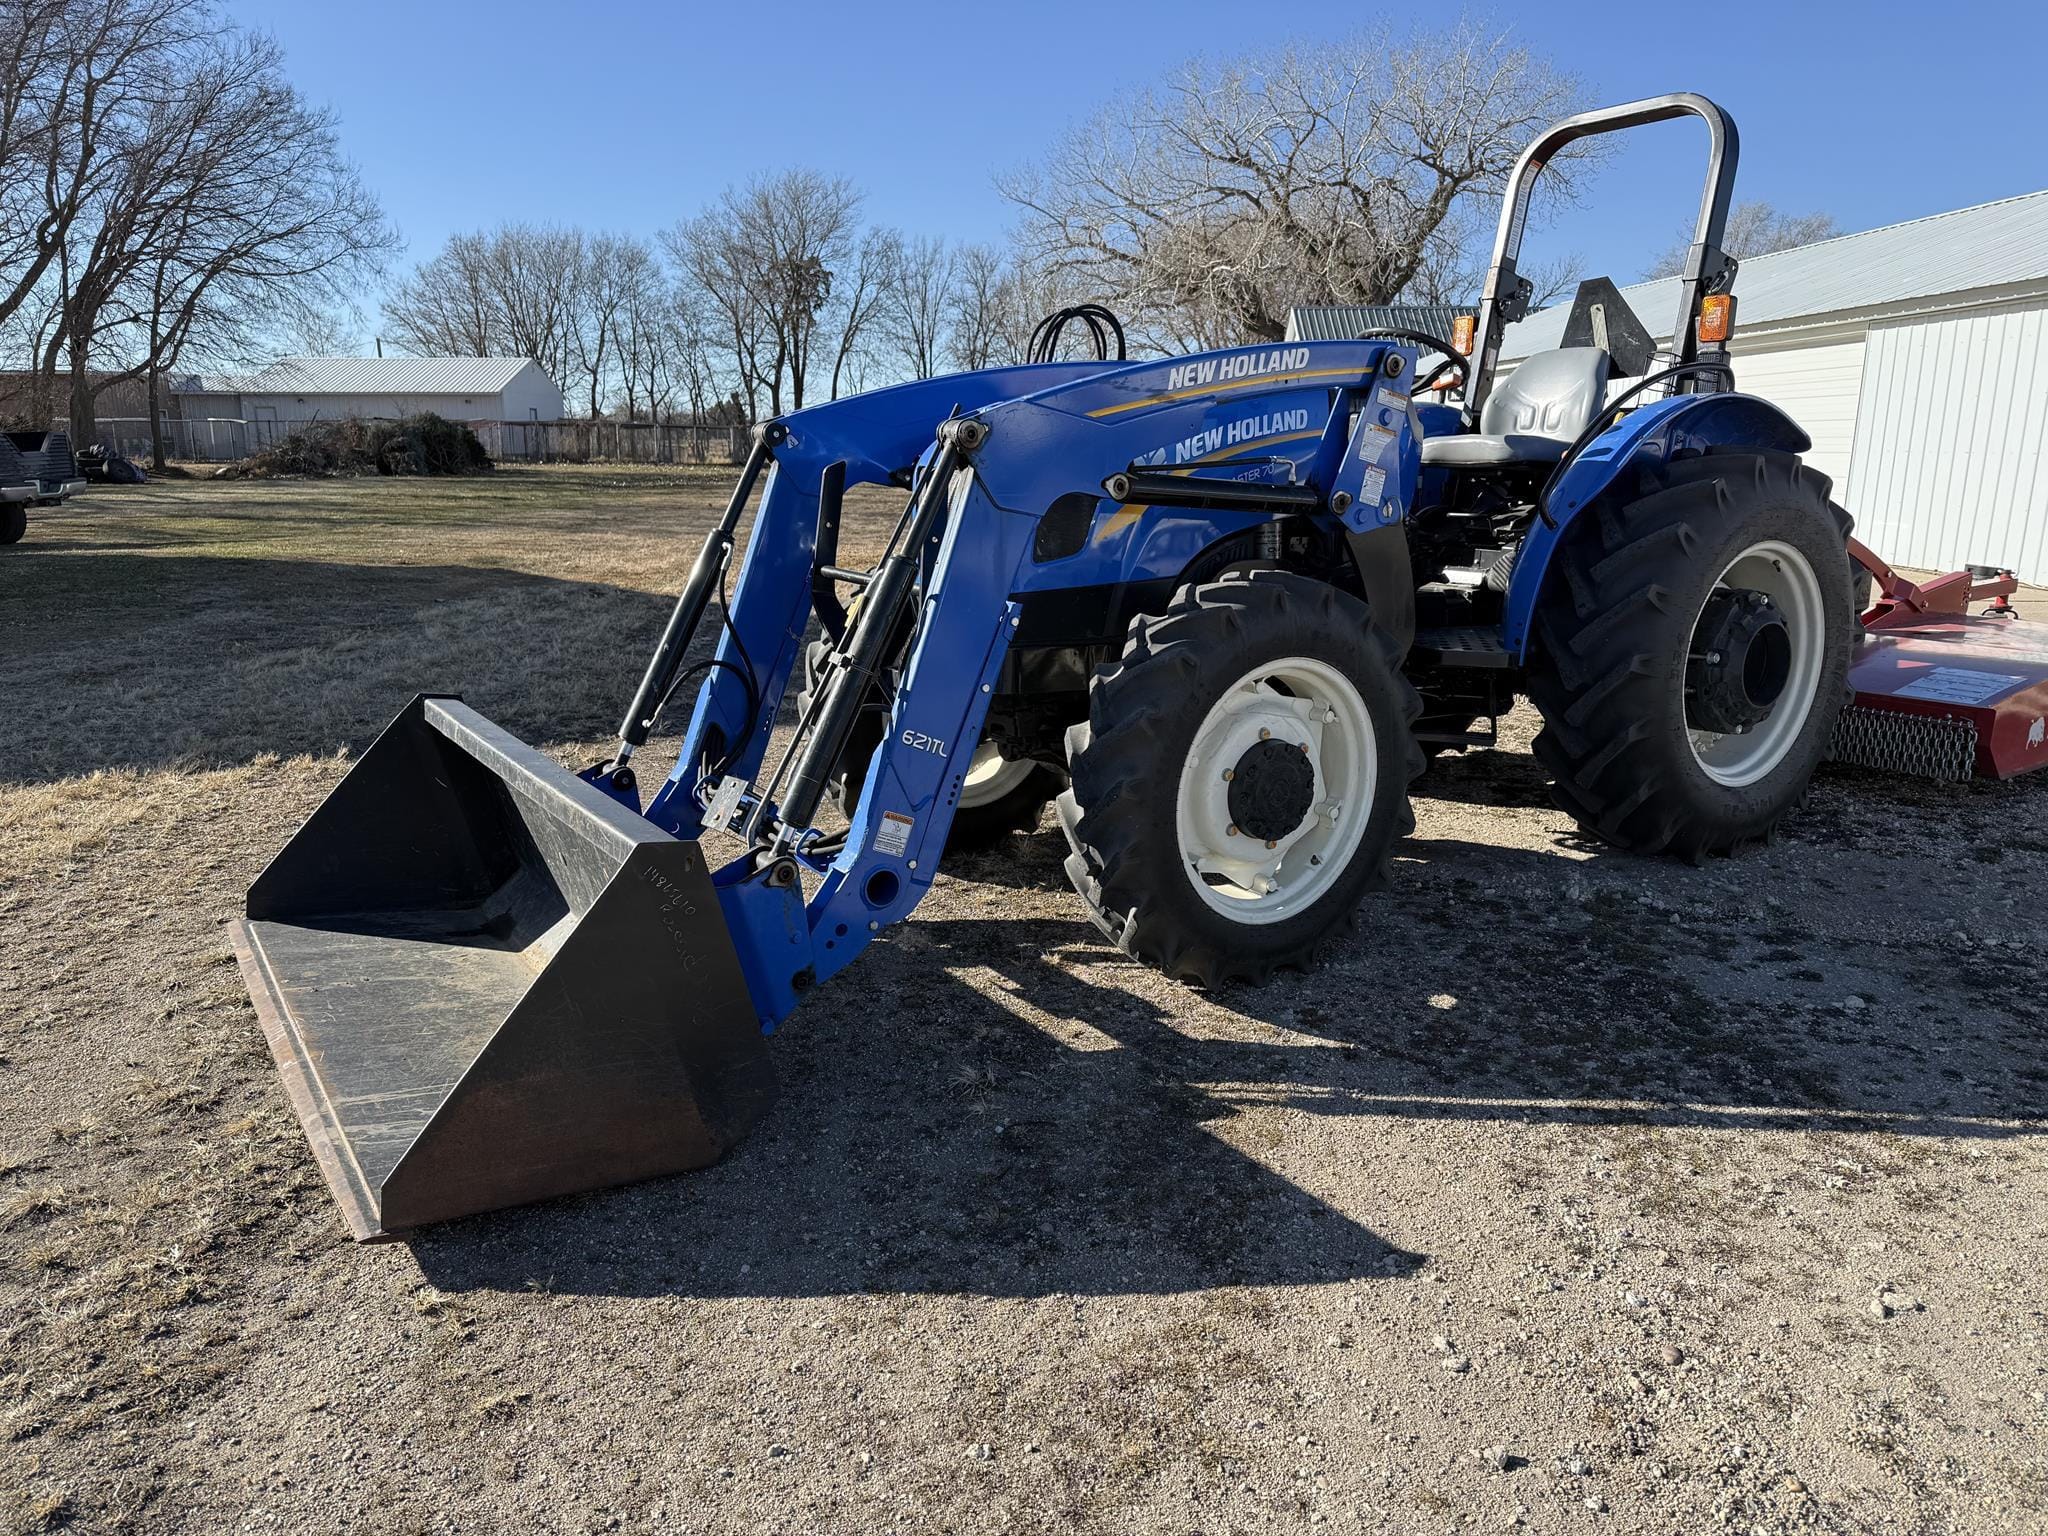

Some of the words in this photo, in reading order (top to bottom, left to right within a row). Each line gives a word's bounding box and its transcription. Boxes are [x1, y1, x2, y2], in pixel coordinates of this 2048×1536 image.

[1168, 360, 1217, 391] NEW
[1219, 347, 1310, 380] HOLLAND
[1175, 426, 1224, 464] NEW
[1227, 409, 1308, 445] HOLLAND
[1262, 463, 1275, 477] 70
[902, 729, 948, 758] 621TL
